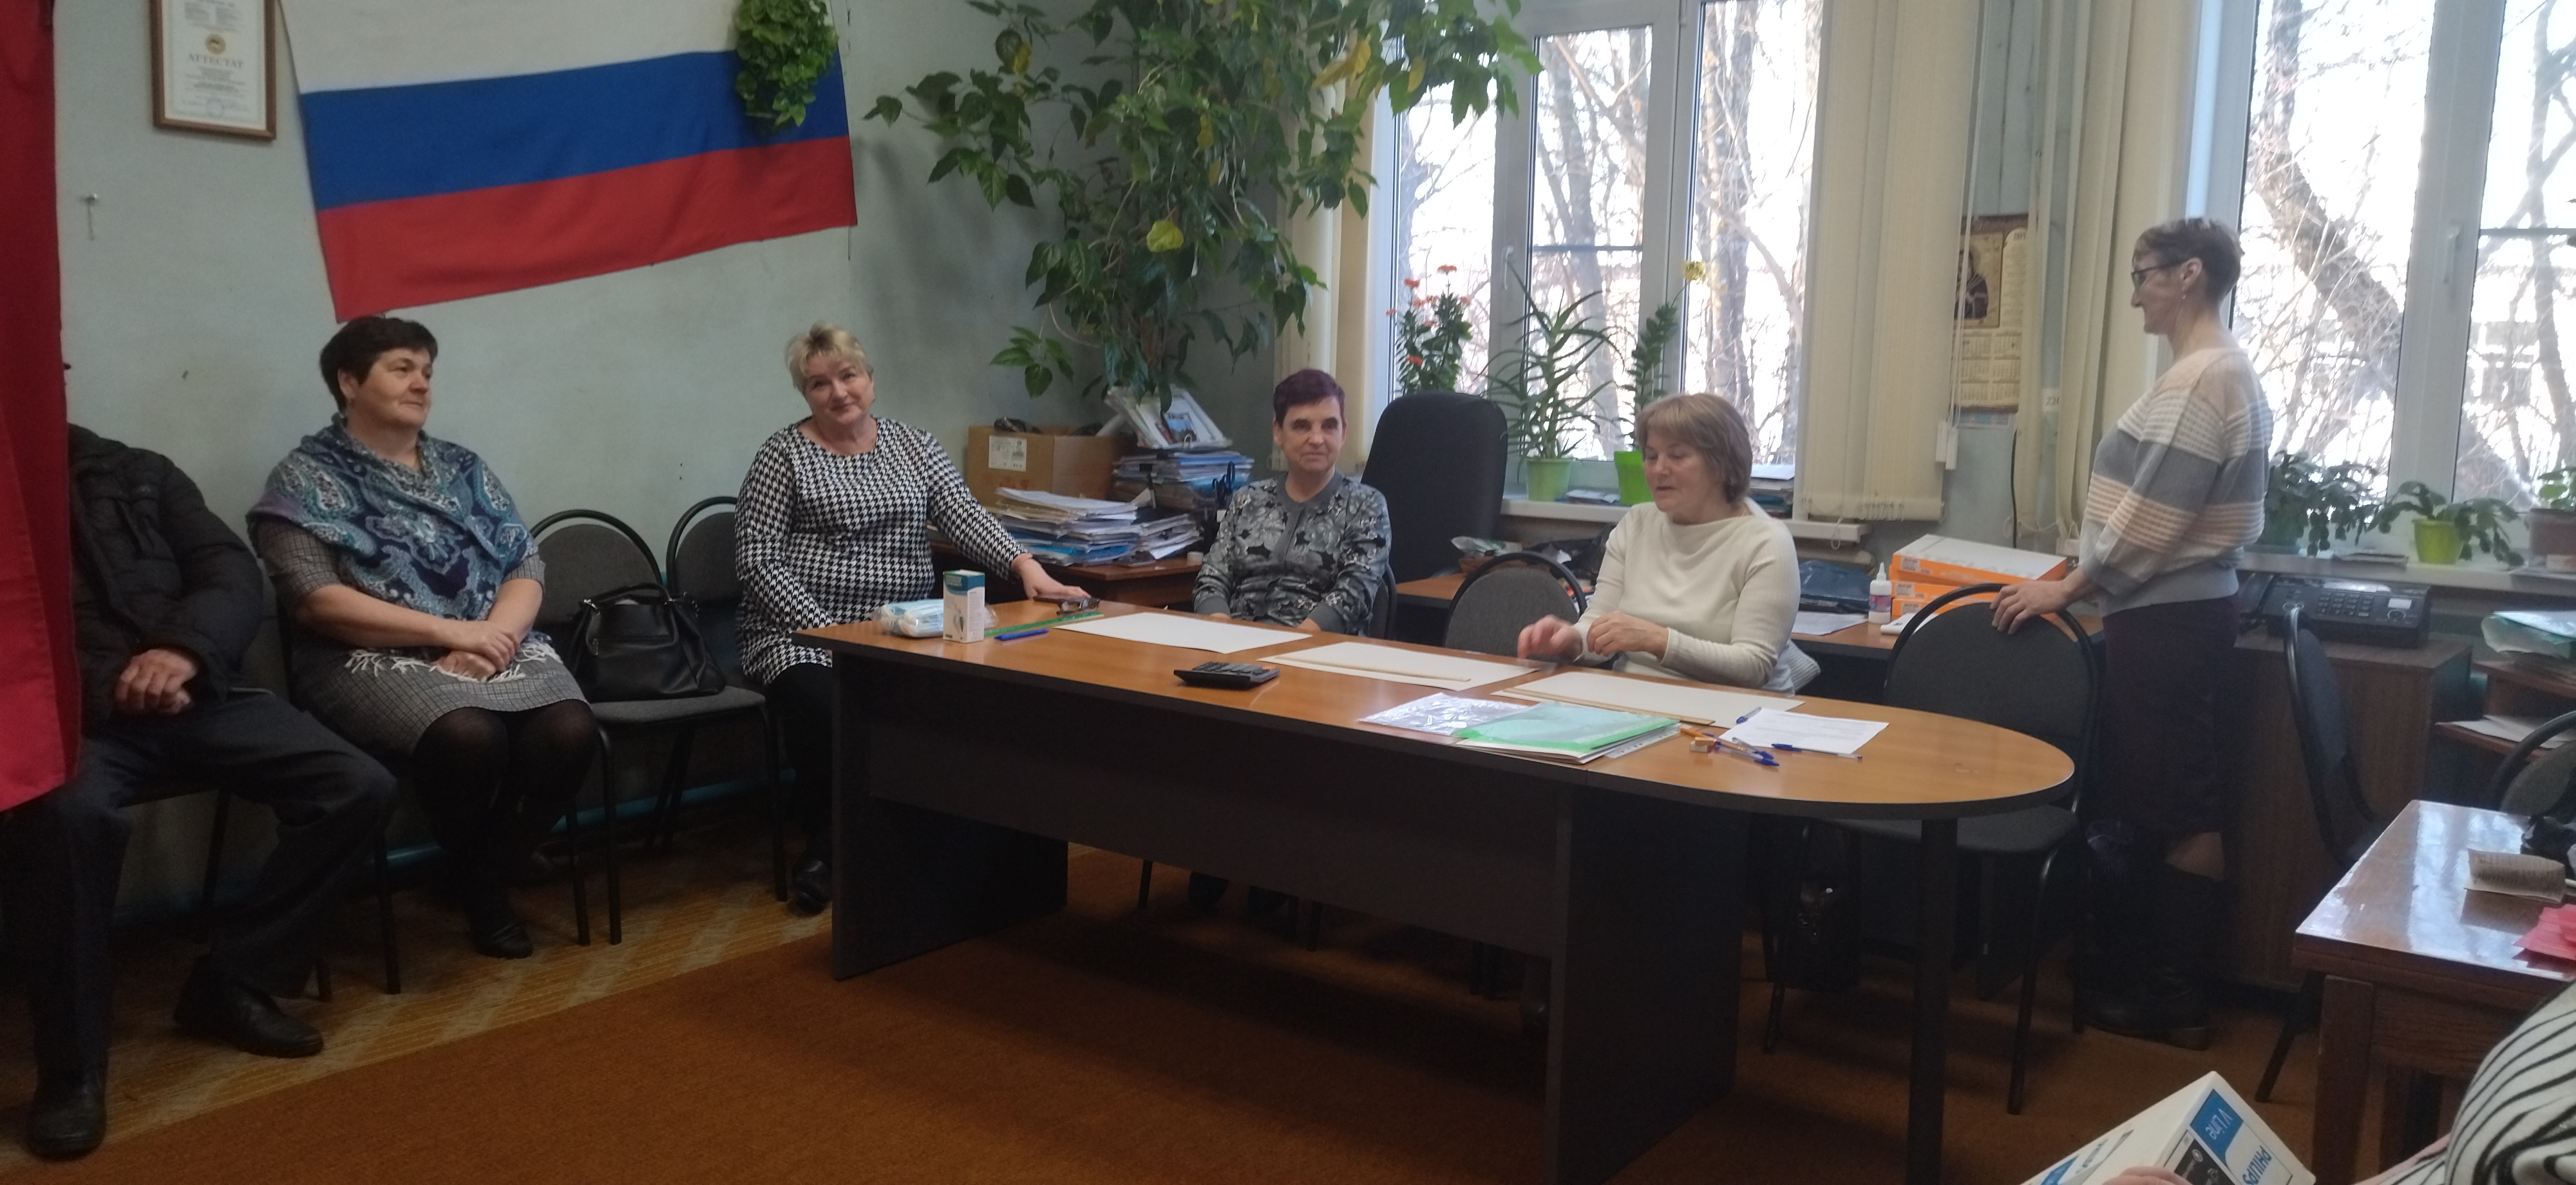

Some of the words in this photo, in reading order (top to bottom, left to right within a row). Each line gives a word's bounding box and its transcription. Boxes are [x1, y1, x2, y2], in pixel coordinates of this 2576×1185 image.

[187, 52, 245, 68] АТТЕСТАТ
[2218, 1108, 2233, 1126] V
[2205, 1114, 2228, 1140] Line
